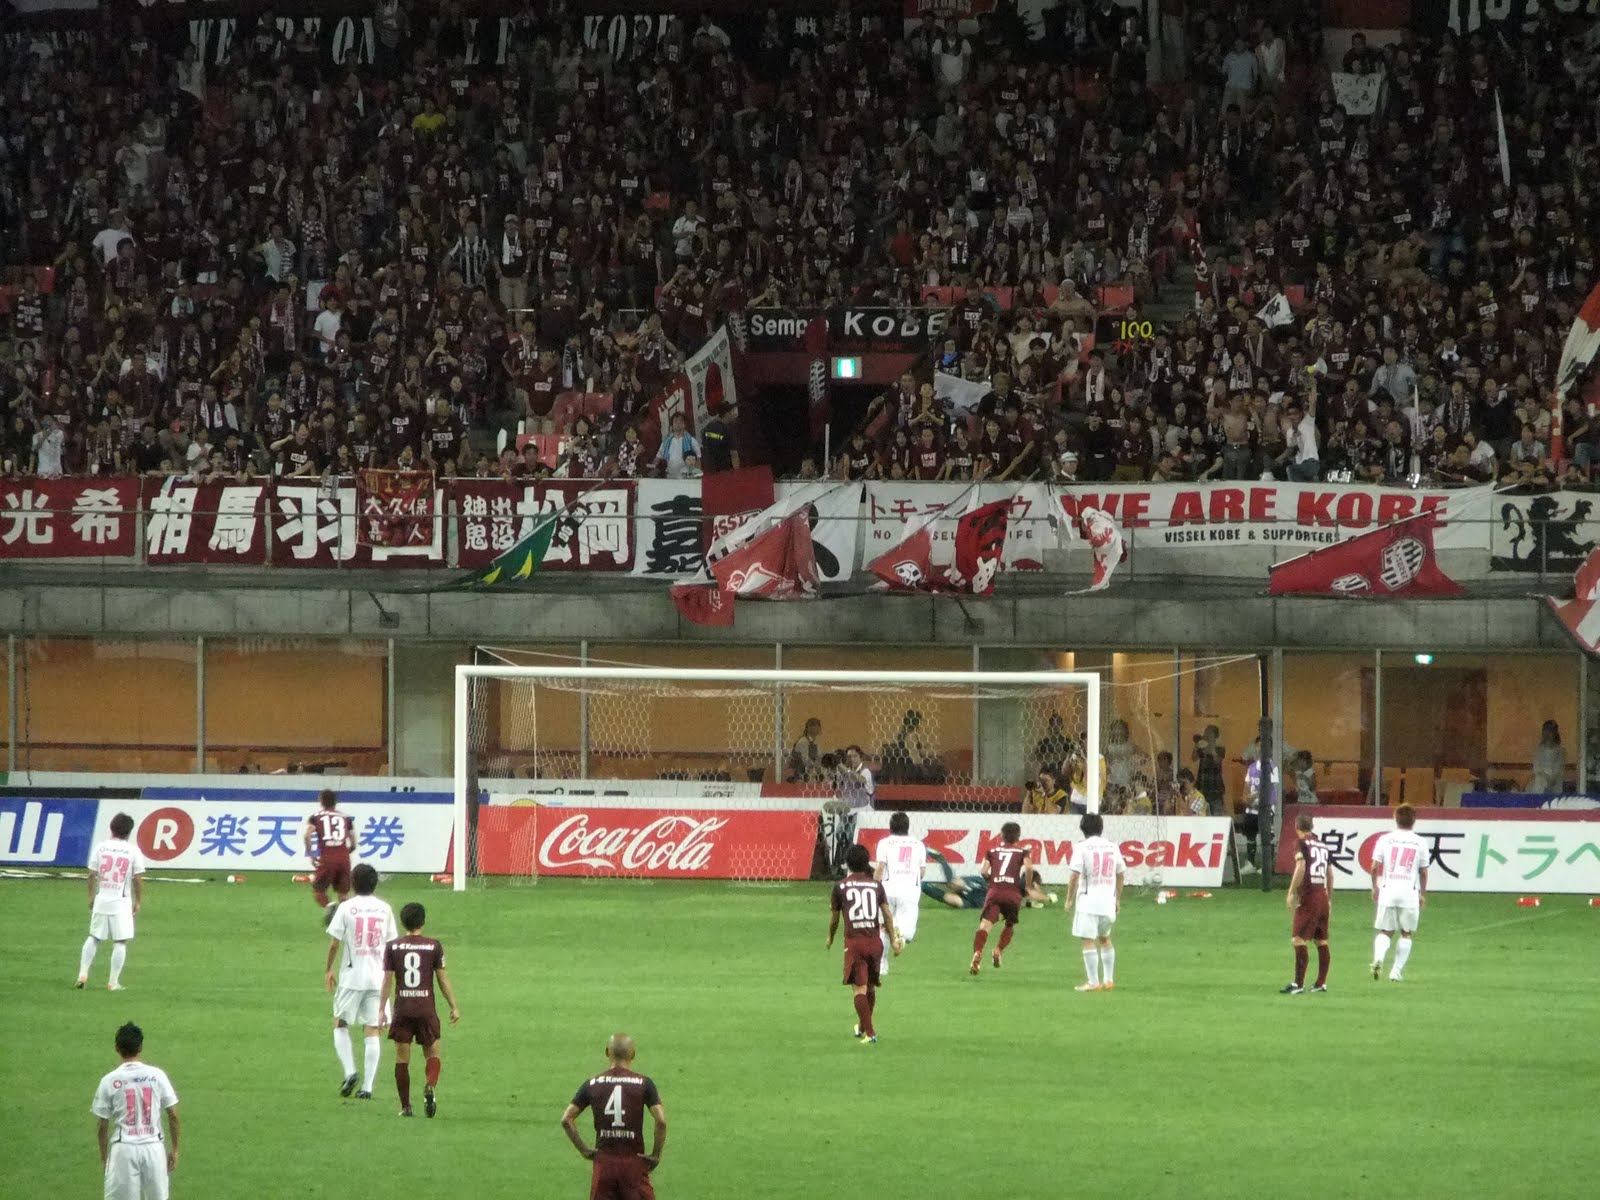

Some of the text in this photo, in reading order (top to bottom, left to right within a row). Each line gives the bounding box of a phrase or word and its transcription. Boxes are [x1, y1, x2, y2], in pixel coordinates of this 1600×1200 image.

[1, 487, 124, 545] 光希
[146, 486, 263, 556] 相馬
[1168, 487, 1277, 527] ARE
[1296, 489, 1449, 529] KOBE
[873, 530, 891, 540] NO
[1165, 528, 1341, 543] VISSEL KOBE & SUPPORTERS
[198, 813, 406, 859] 楽天券
[319, 815, 345, 841] 13
[975, 829, 1224, 869] Kawsaki
[998, 852, 1013, 876] 7
[100, 854, 129, 884] 23
[846, 888, 877, 921] 20
[404, 951, 421, 988] 8
[125, 1087, 153, 1126] 11
[604, 1084, 626, 1127] 4
